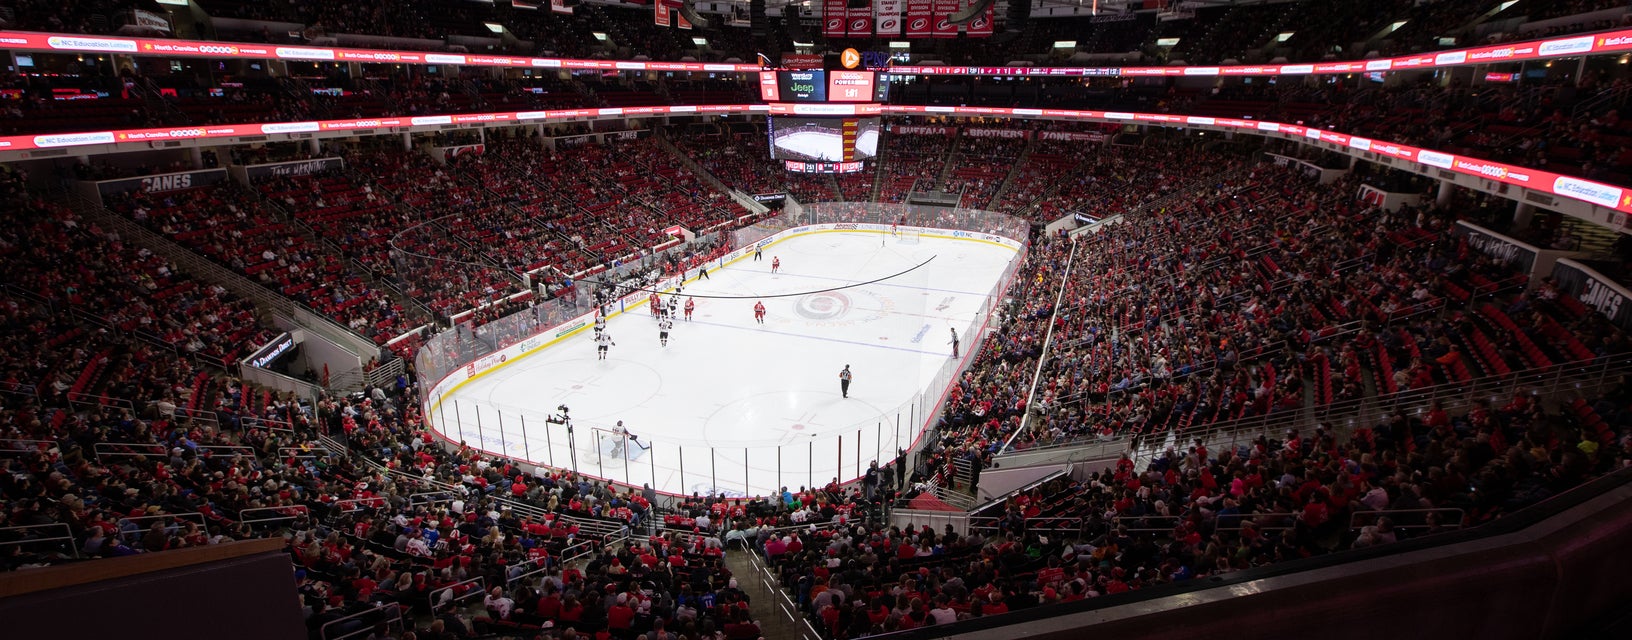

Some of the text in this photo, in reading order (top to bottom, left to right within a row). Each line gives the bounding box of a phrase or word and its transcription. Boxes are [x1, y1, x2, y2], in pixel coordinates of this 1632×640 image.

[790, 82, 814, 93] Jeep
[900, 126, 946, 134] BUFFALO
[970, 128, 1024, 138] BROTHERS
[57, 136, 88, 144] Education
[1043, 132, 1071, 140] ZONE
[270, 160, 327, 177] TAKE WARNING
[142, 174, 191, 192] CANES
[1580, 278, 1622, 320] CANES
